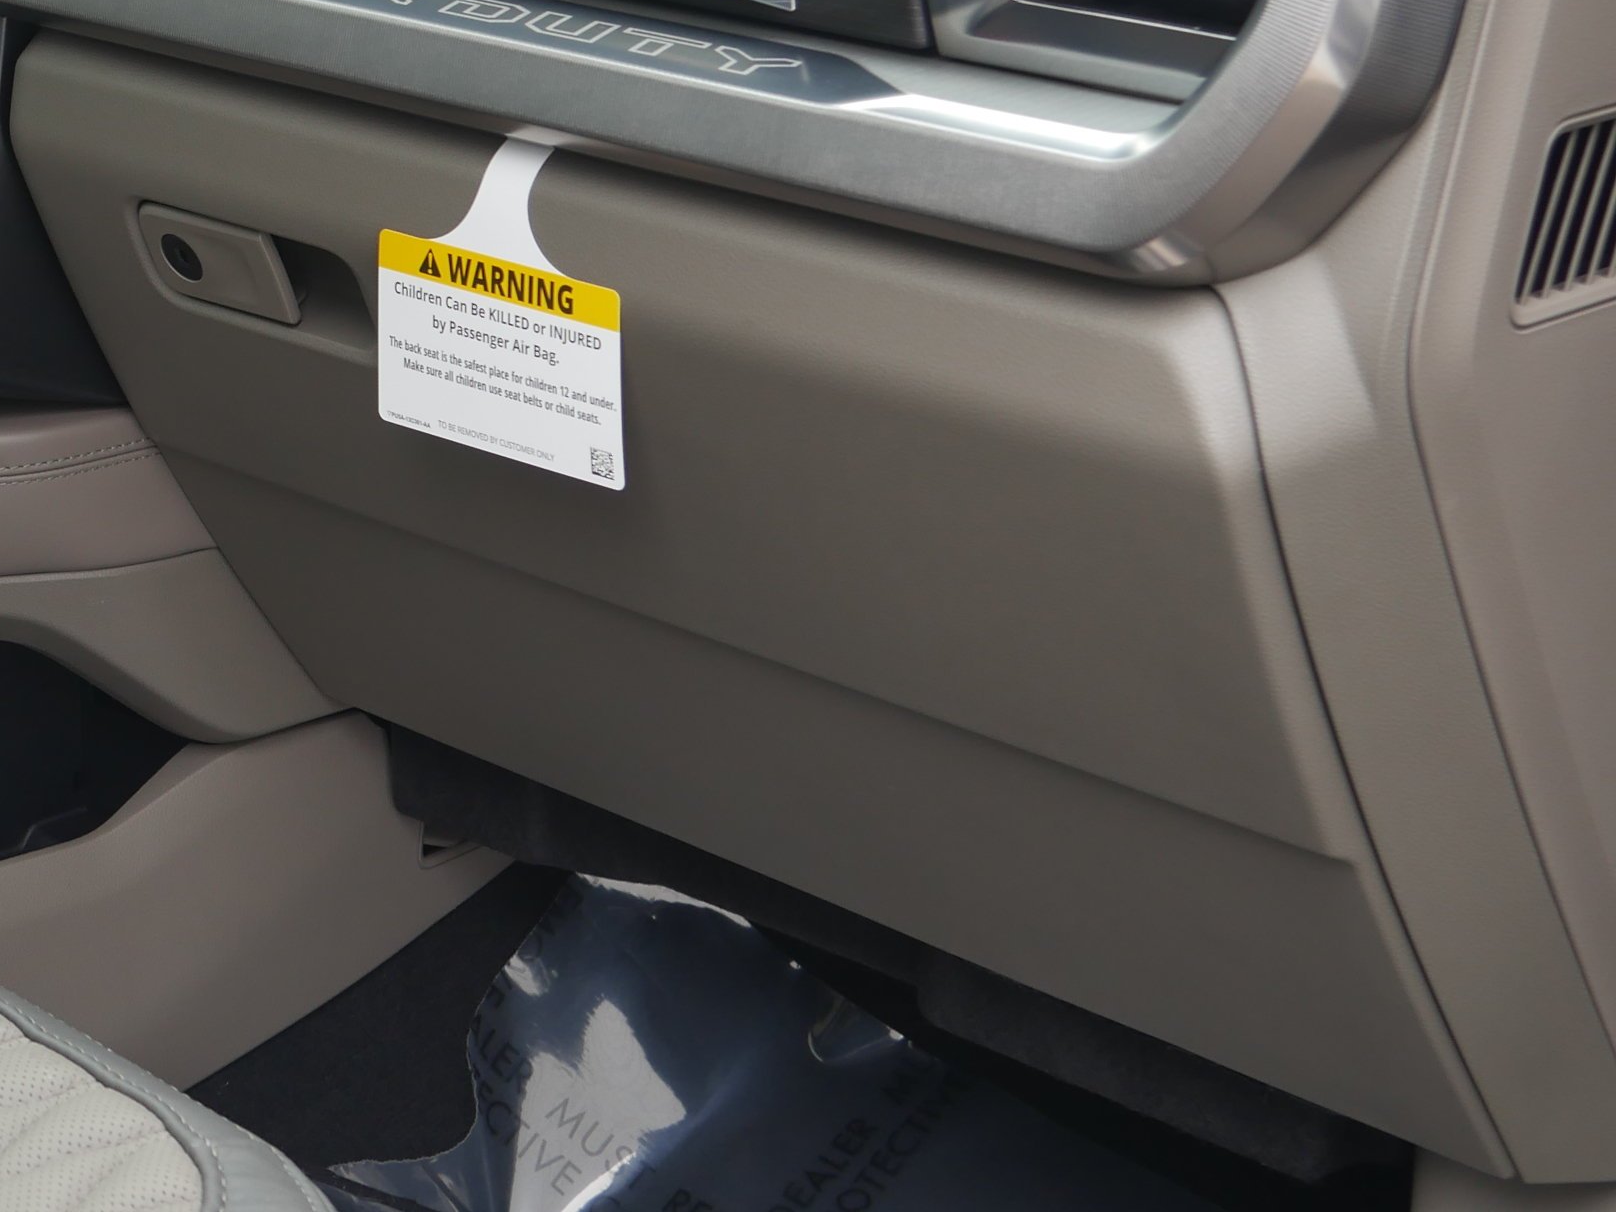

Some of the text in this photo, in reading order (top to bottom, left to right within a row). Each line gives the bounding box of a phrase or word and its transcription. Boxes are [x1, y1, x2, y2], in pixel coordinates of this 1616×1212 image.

[394, 281, 602, 351] Children Can Be KILLED or INJURED
[447, 253, 574, 315] WARNING
[432, 314, 560, 367] by Passenger Air Bag.
[389, 335, 618, 412] The back seat is the safest place for children 12 and under.
[403, 357, 602, 426] Make sure all children use seat belts or child seats.
[437, 419, 556, 462] TO BE REMOVED BY CUSTOMER ONLY
